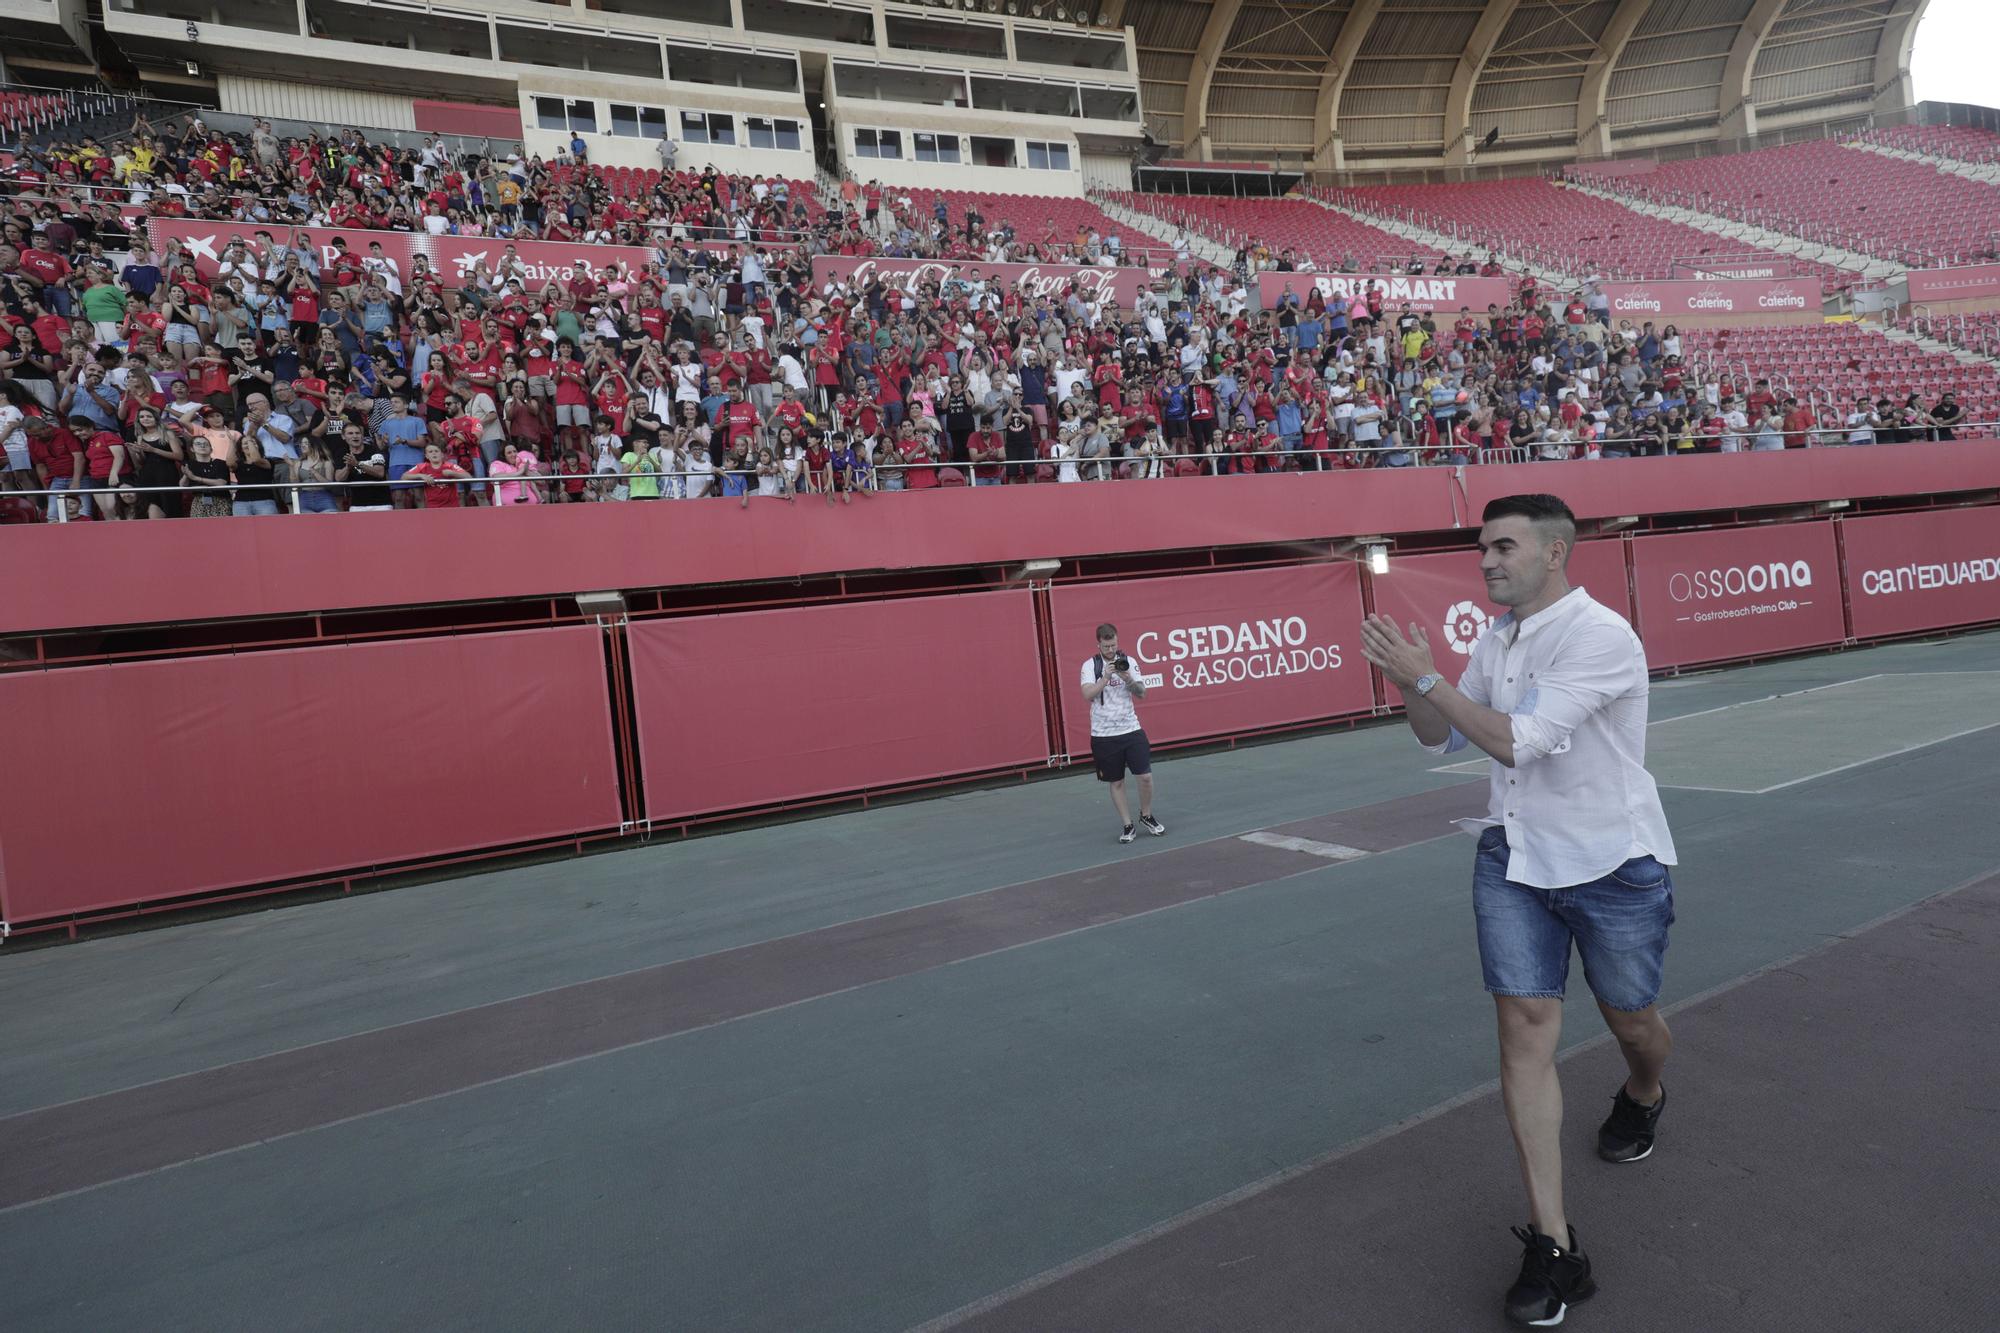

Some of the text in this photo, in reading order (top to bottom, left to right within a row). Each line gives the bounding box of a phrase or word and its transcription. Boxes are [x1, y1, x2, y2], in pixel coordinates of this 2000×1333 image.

[1614, 297, 1661, 312] Catering
[1687, 296, 1733, 311] Catering
[1758, 295, 1805, 308] Catering
[1669, 560, 1812, 602] assaona
[1693, 600, 1797, 622] Gastrobeach Palma Club
[1172, 644, 1342, 689] &ASOCIADOS
